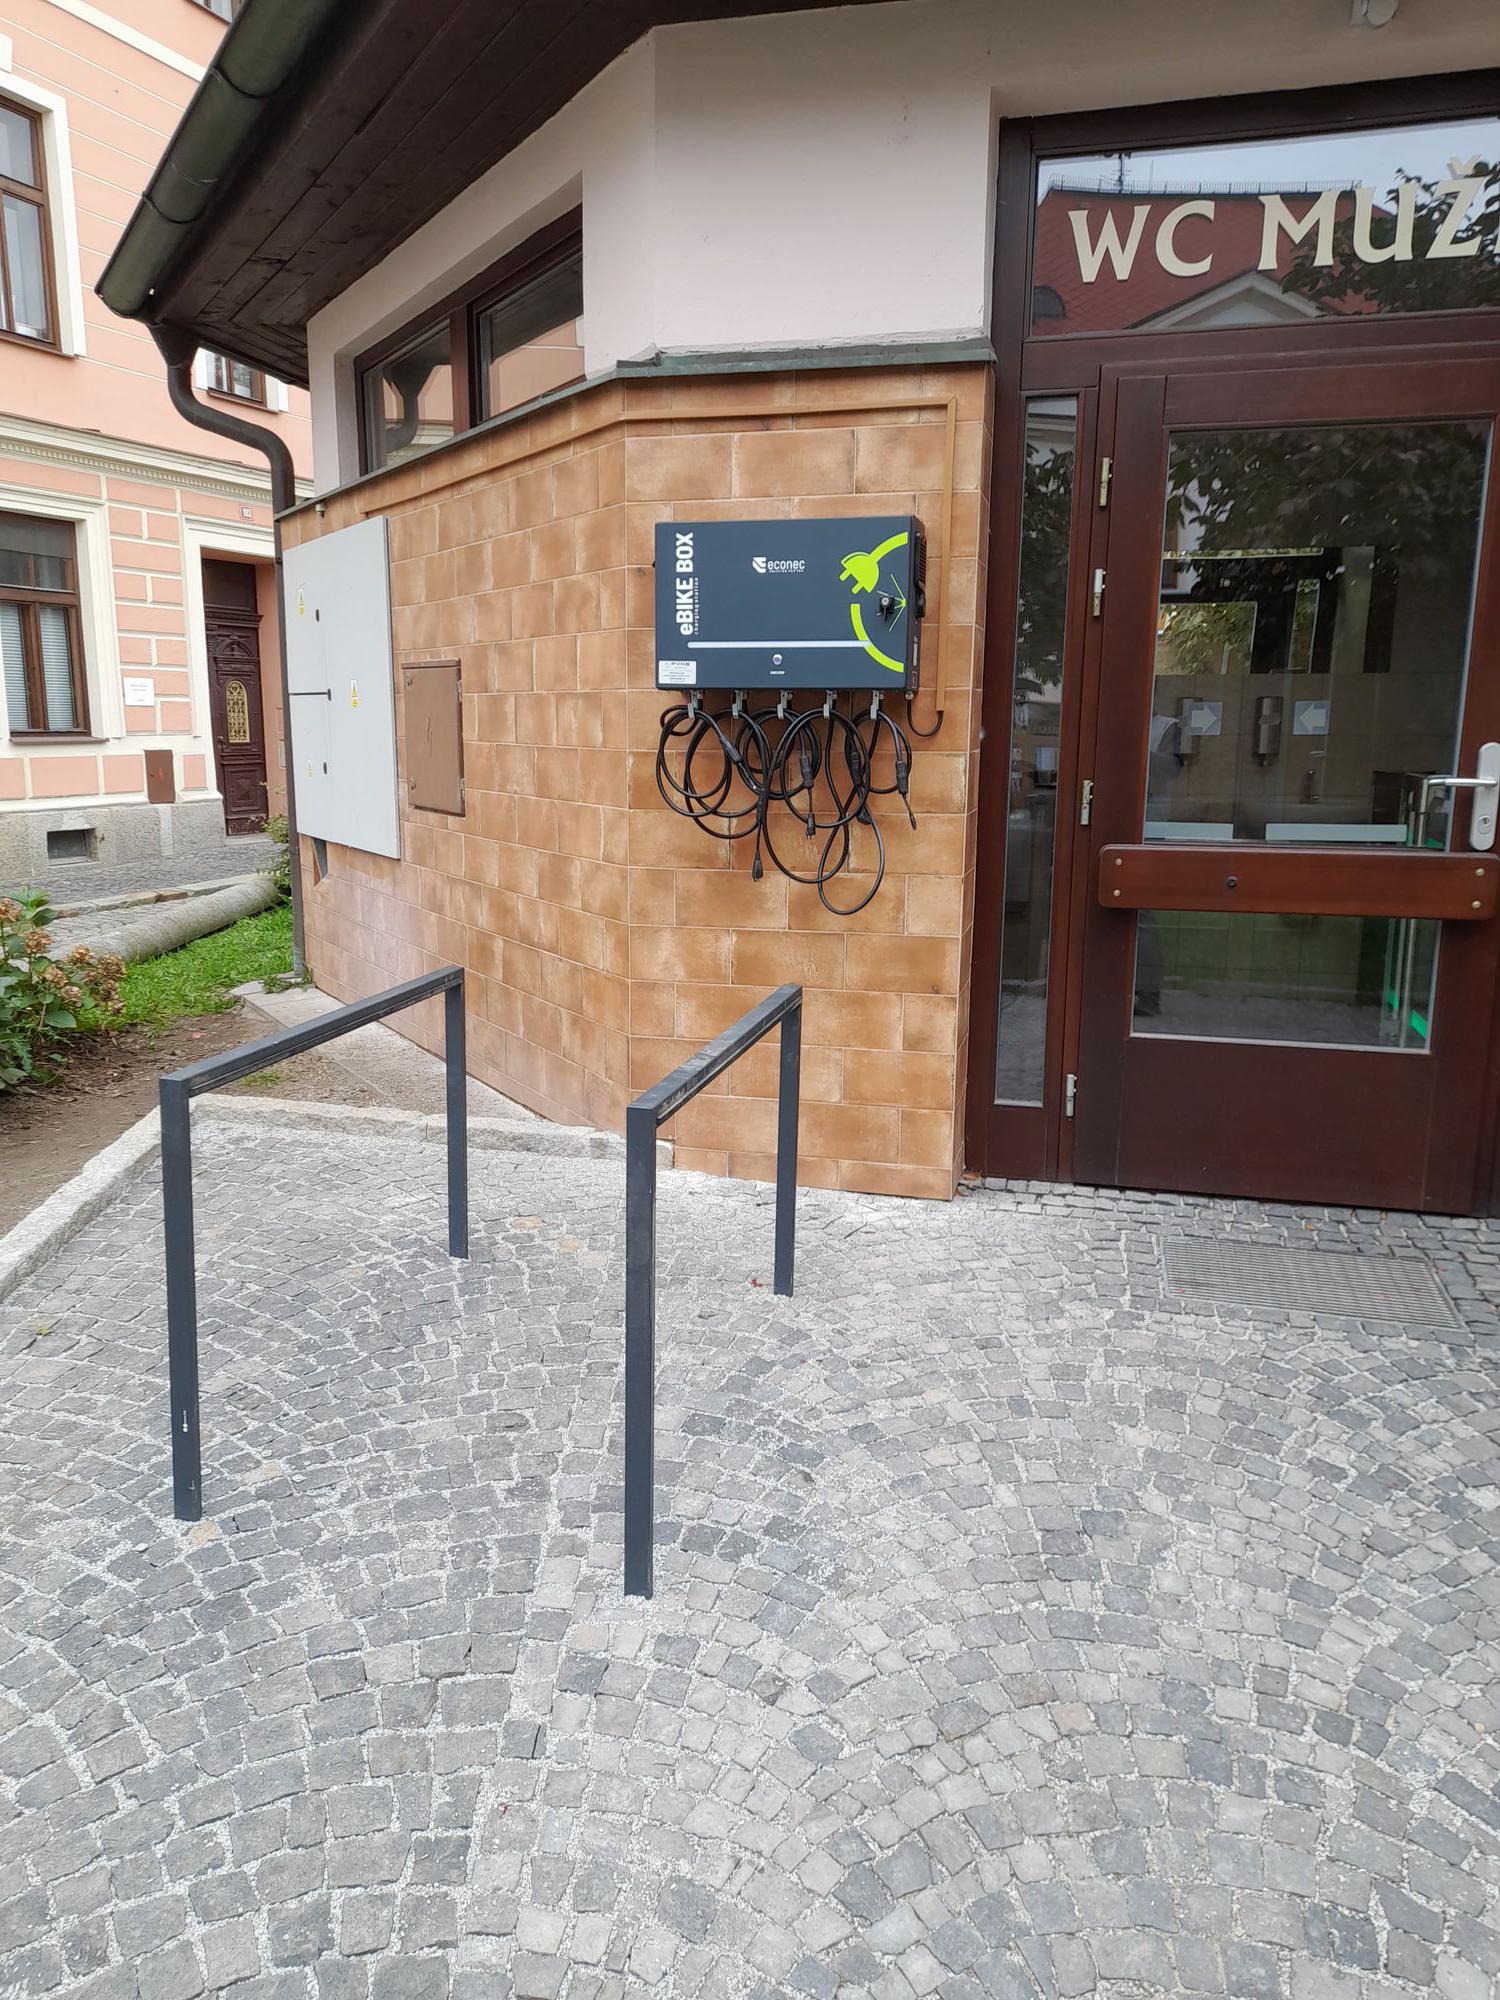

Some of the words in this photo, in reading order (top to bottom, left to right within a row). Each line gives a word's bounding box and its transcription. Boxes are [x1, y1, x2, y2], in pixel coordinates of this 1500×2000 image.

[1068, 199, 1216, 284] WC
[1257, 154, 1500, 272] MUŽ
[676, 532, 694, 573] BOX
[767, 560, 805, 569] econec
[676, 577, 694, 635] eBIKE
